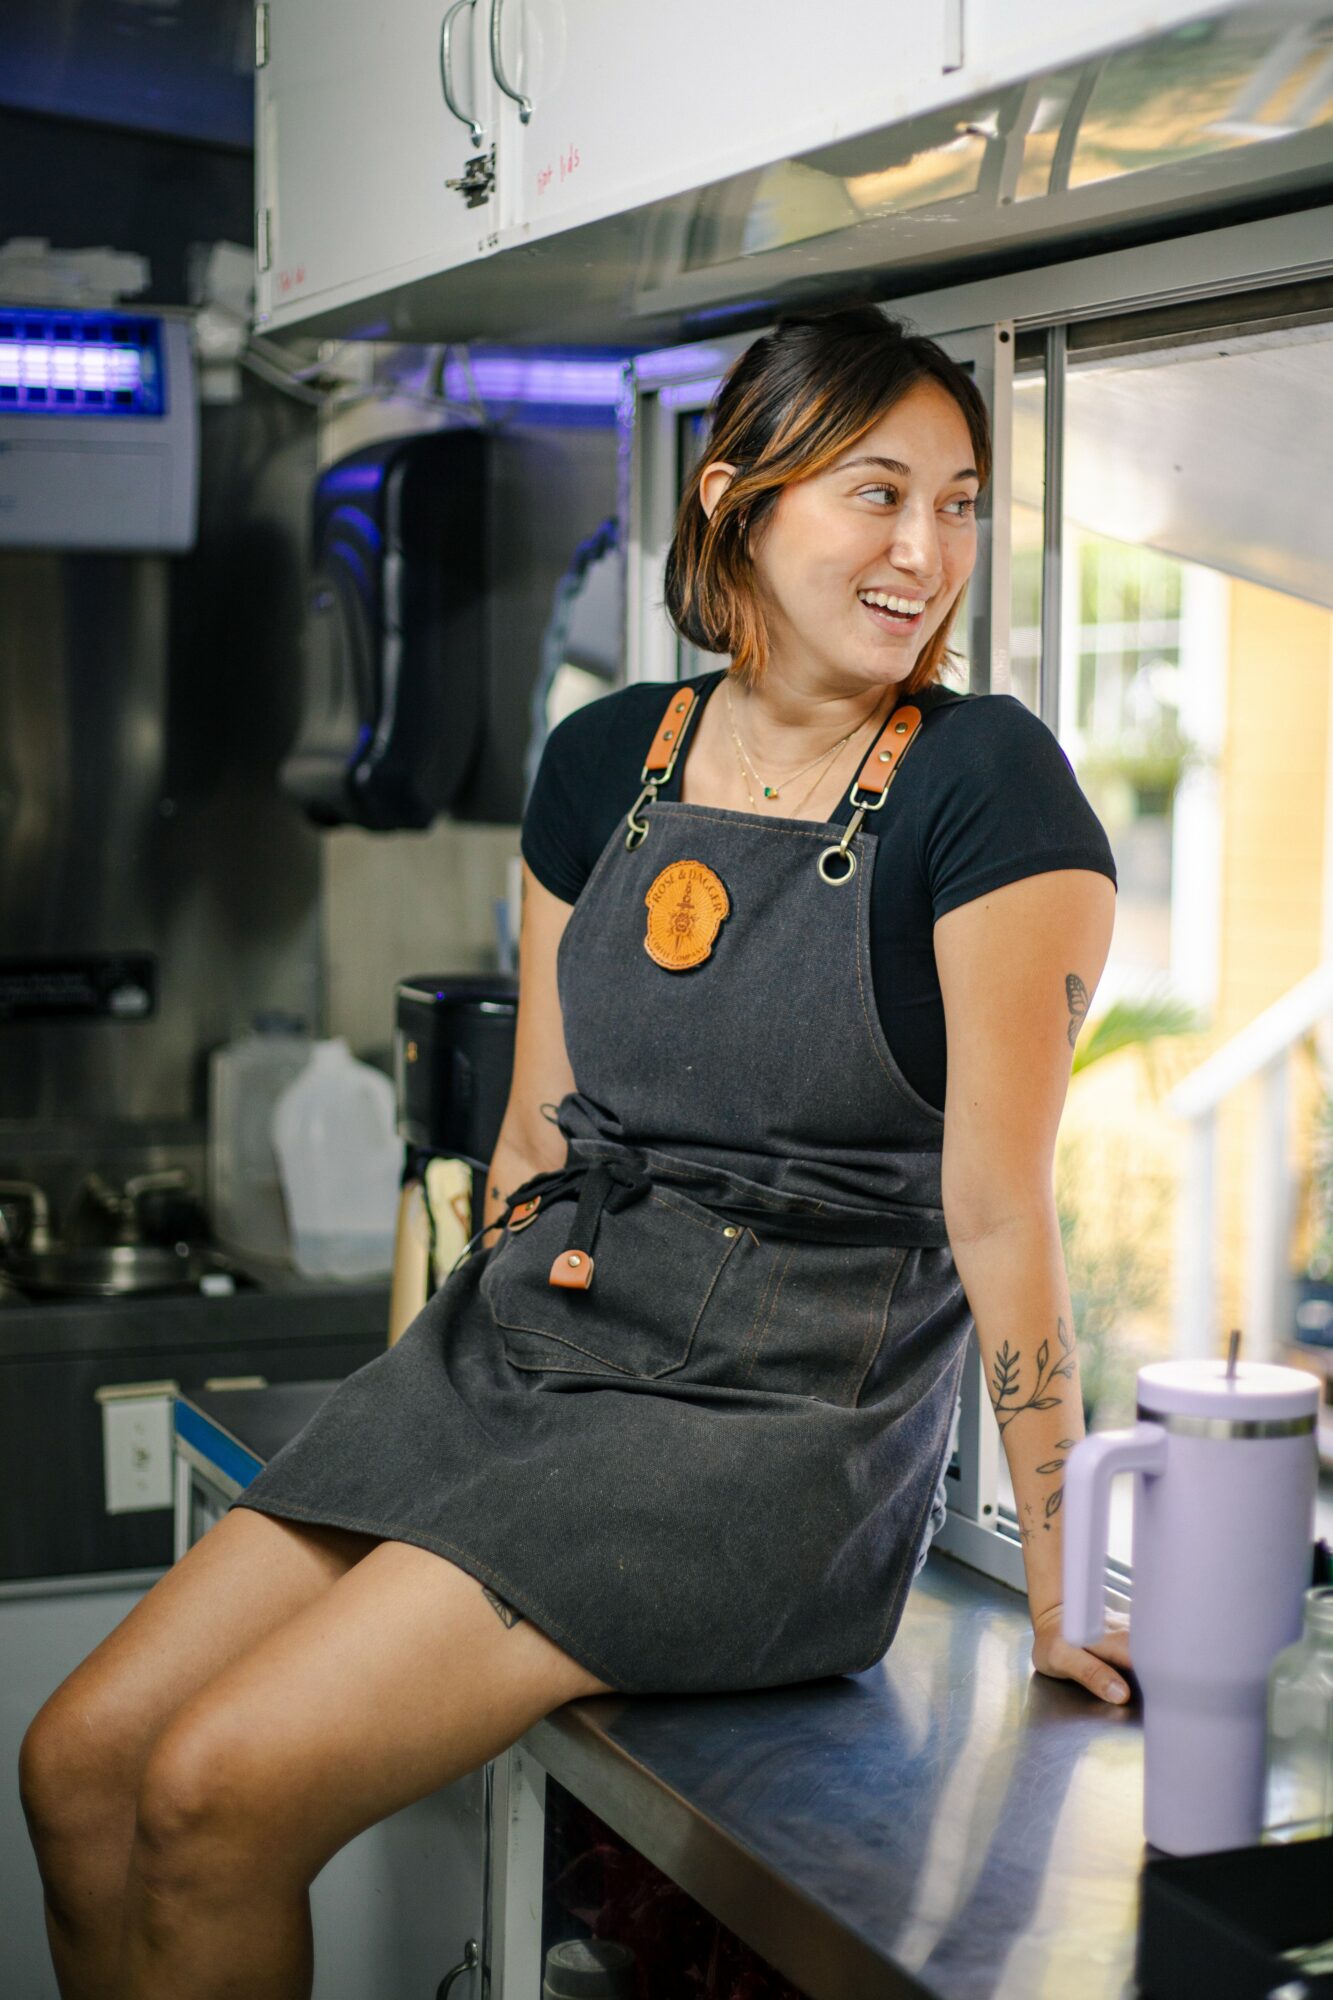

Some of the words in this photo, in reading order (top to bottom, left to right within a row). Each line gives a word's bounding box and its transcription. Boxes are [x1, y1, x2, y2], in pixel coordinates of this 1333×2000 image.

[652, 873, 675, 903] ROSE
[678, 868, 687, 880] &
[688, 868, 723, 913] DAGGER
